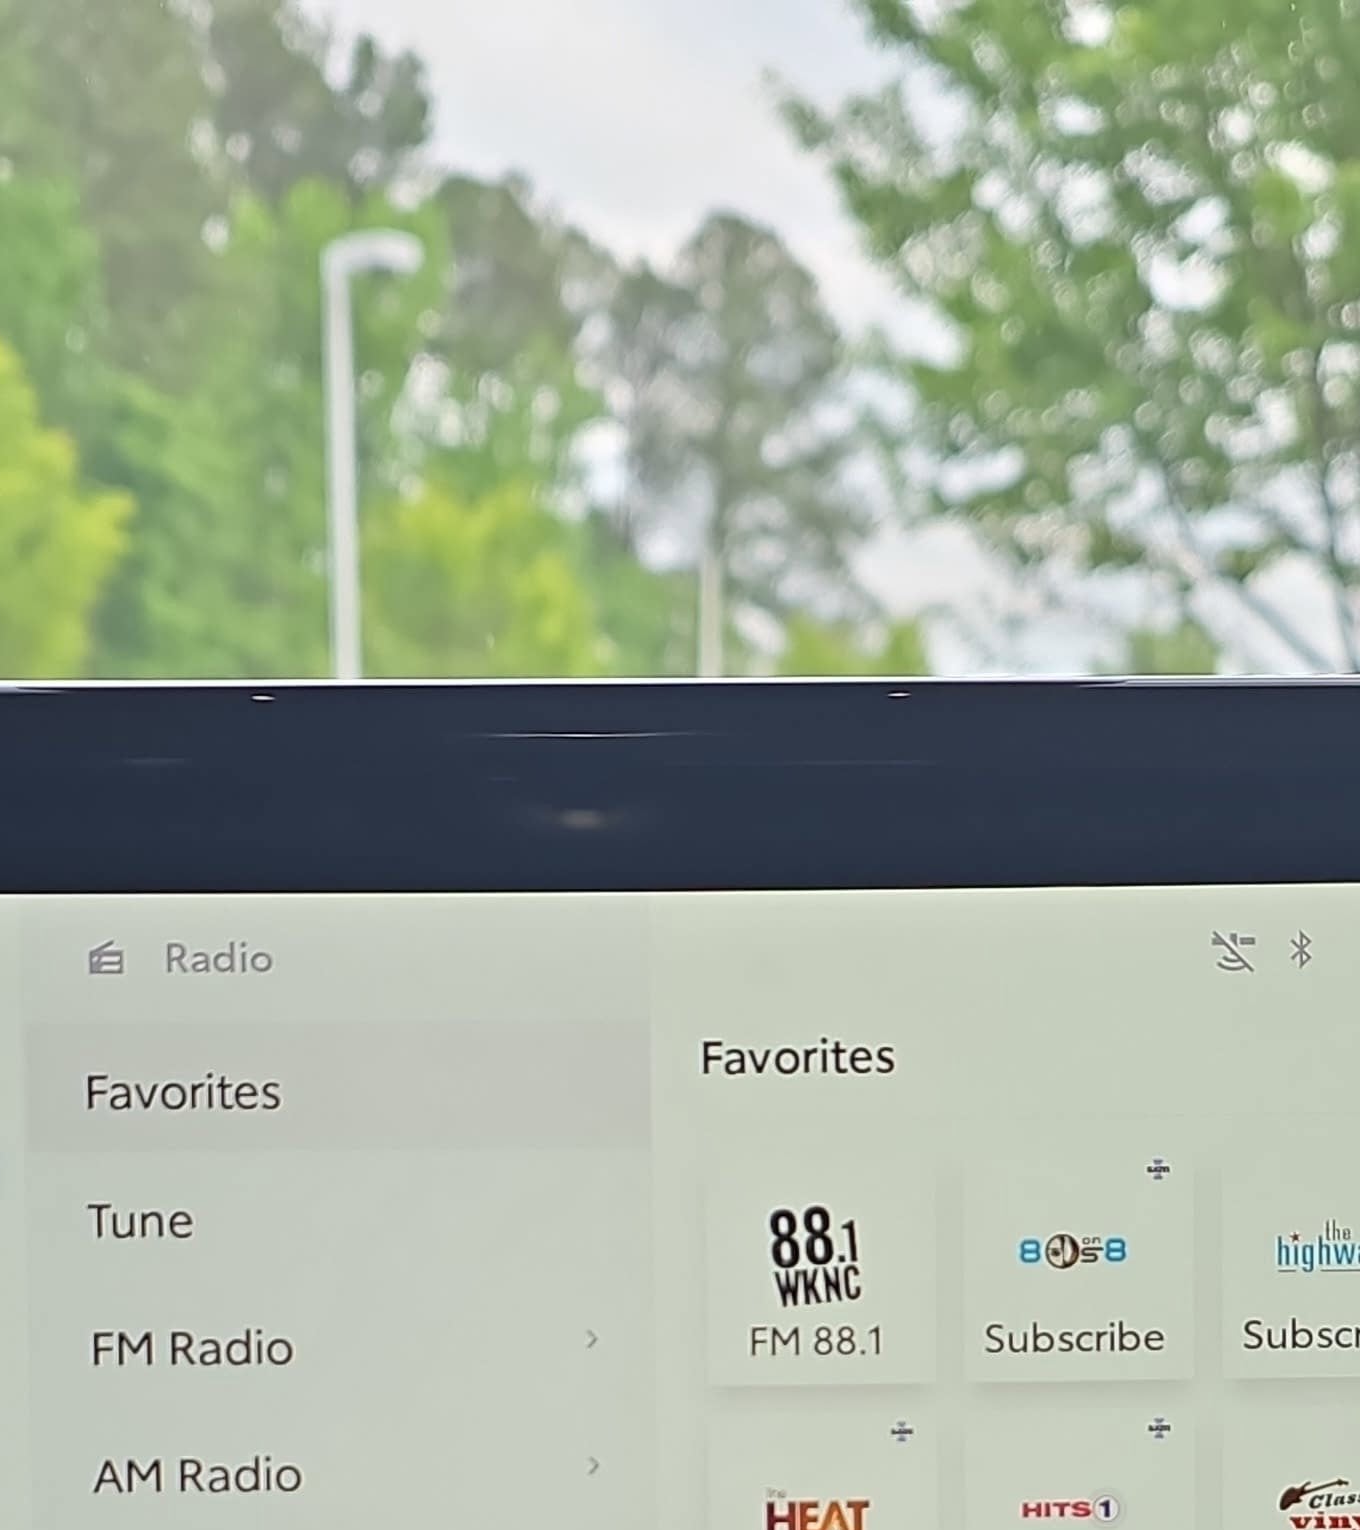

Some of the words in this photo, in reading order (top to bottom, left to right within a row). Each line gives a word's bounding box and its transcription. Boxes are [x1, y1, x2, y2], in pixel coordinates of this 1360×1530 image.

[166, 941, 273, 974] Radio
[702, 1037, 895, 1076] Favorites
[87, 1072, 281, 1111] Favorites
[87, 1203, 193, 1239] Tune
[769, 1204, 859, 1269] 88.1
[1325, 1218, 1352, 1241] the
[774, 1264, 862, 1308] WKNC
[93, 1331, 153, 1366] FM
[170, 1328, 293, 1367] Radio
[751, 1326, 800, 1357] FM
[813, 1325, 881, 1356] 88.1
[985, 1320, 1165, 1354] Subscribe
[93, 1459, 162, 1494] AM
[179, 1455, 302, 1494] Radio
[1022, 1501, 1092, 1518] HITS
